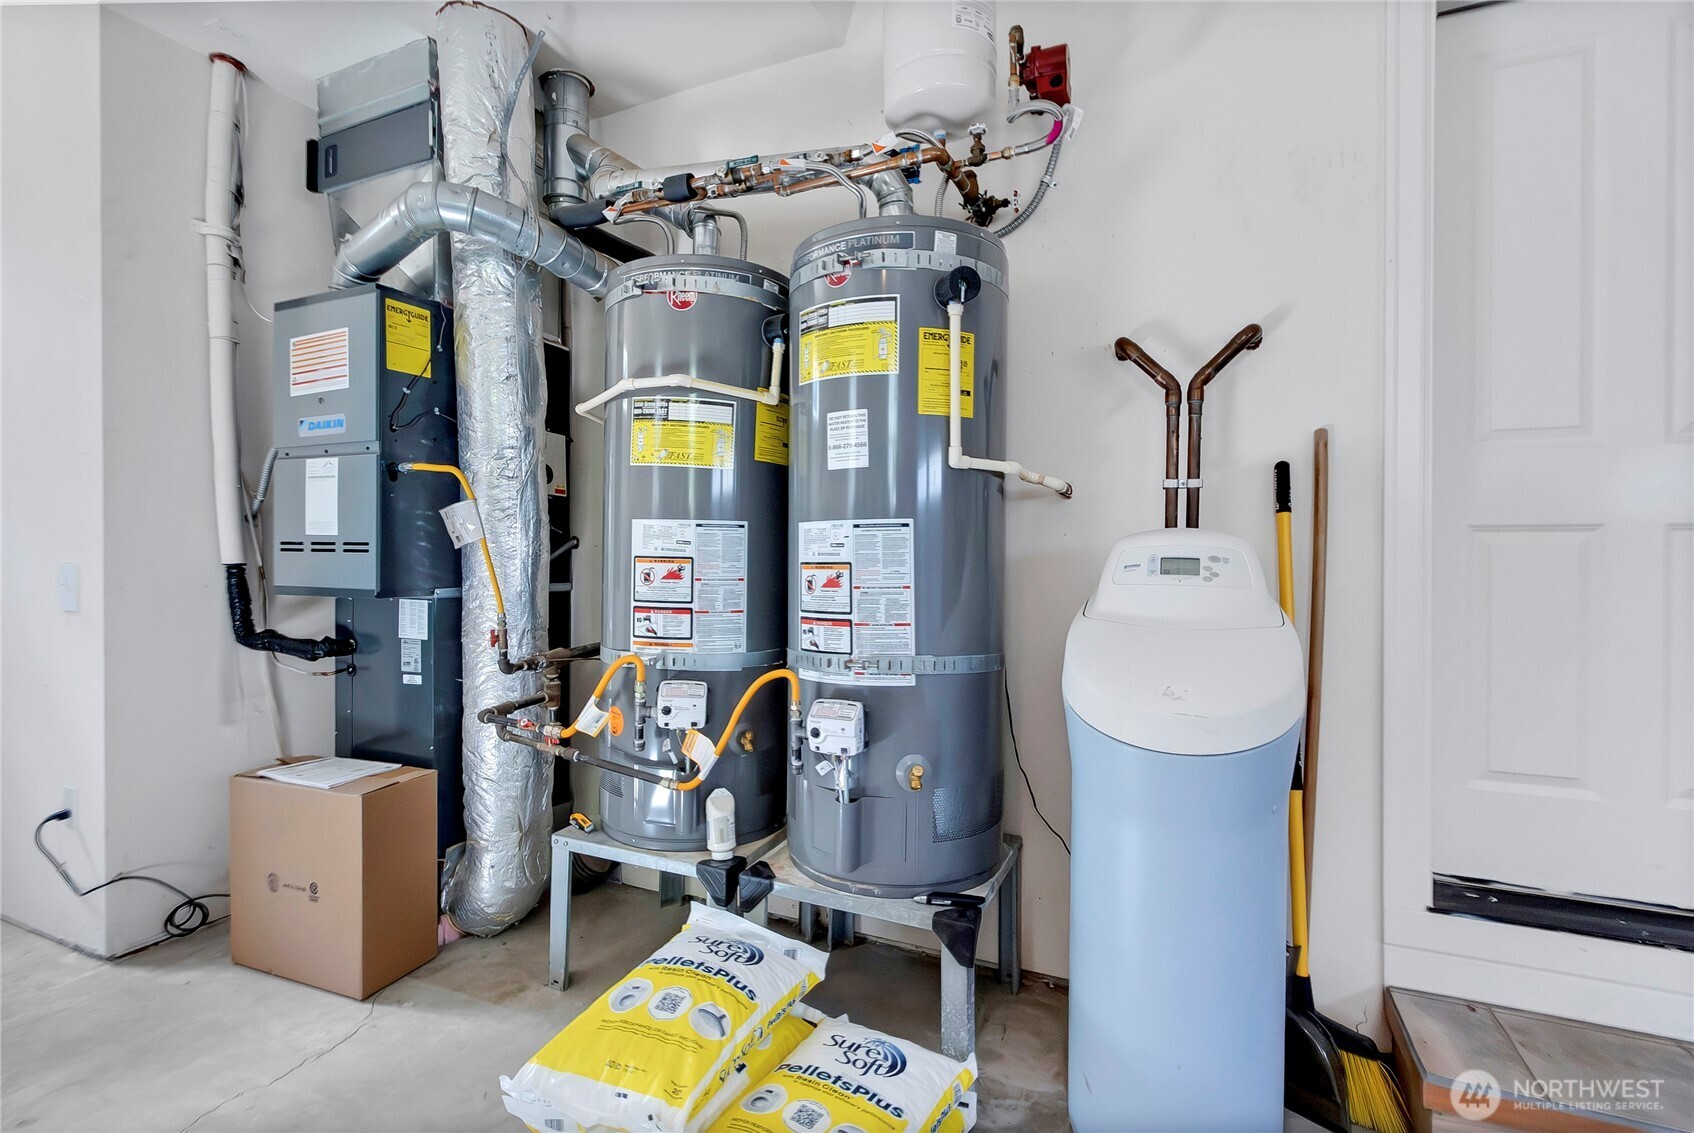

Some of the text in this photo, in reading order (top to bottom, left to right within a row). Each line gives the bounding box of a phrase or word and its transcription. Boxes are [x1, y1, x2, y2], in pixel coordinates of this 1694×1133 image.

[848, 235, 900, 248] PLATINUM
[830, 360, 853, 371] FAST
[307, 418, 344, 431] DAIKIN
[669, 452, 692, 460] FAST
[688, 935, 742, 951] Sure
[698, 944, 746, 963] Soft
[823, 1034, 881, 1059] Sure
[834, 1050, 890, 1077] Soft
[774, 1063, 906, 1119] pelletsPlus
[795, 1075, 820, 1087] Resin
[822, 1083, 851, 1100] Clean
